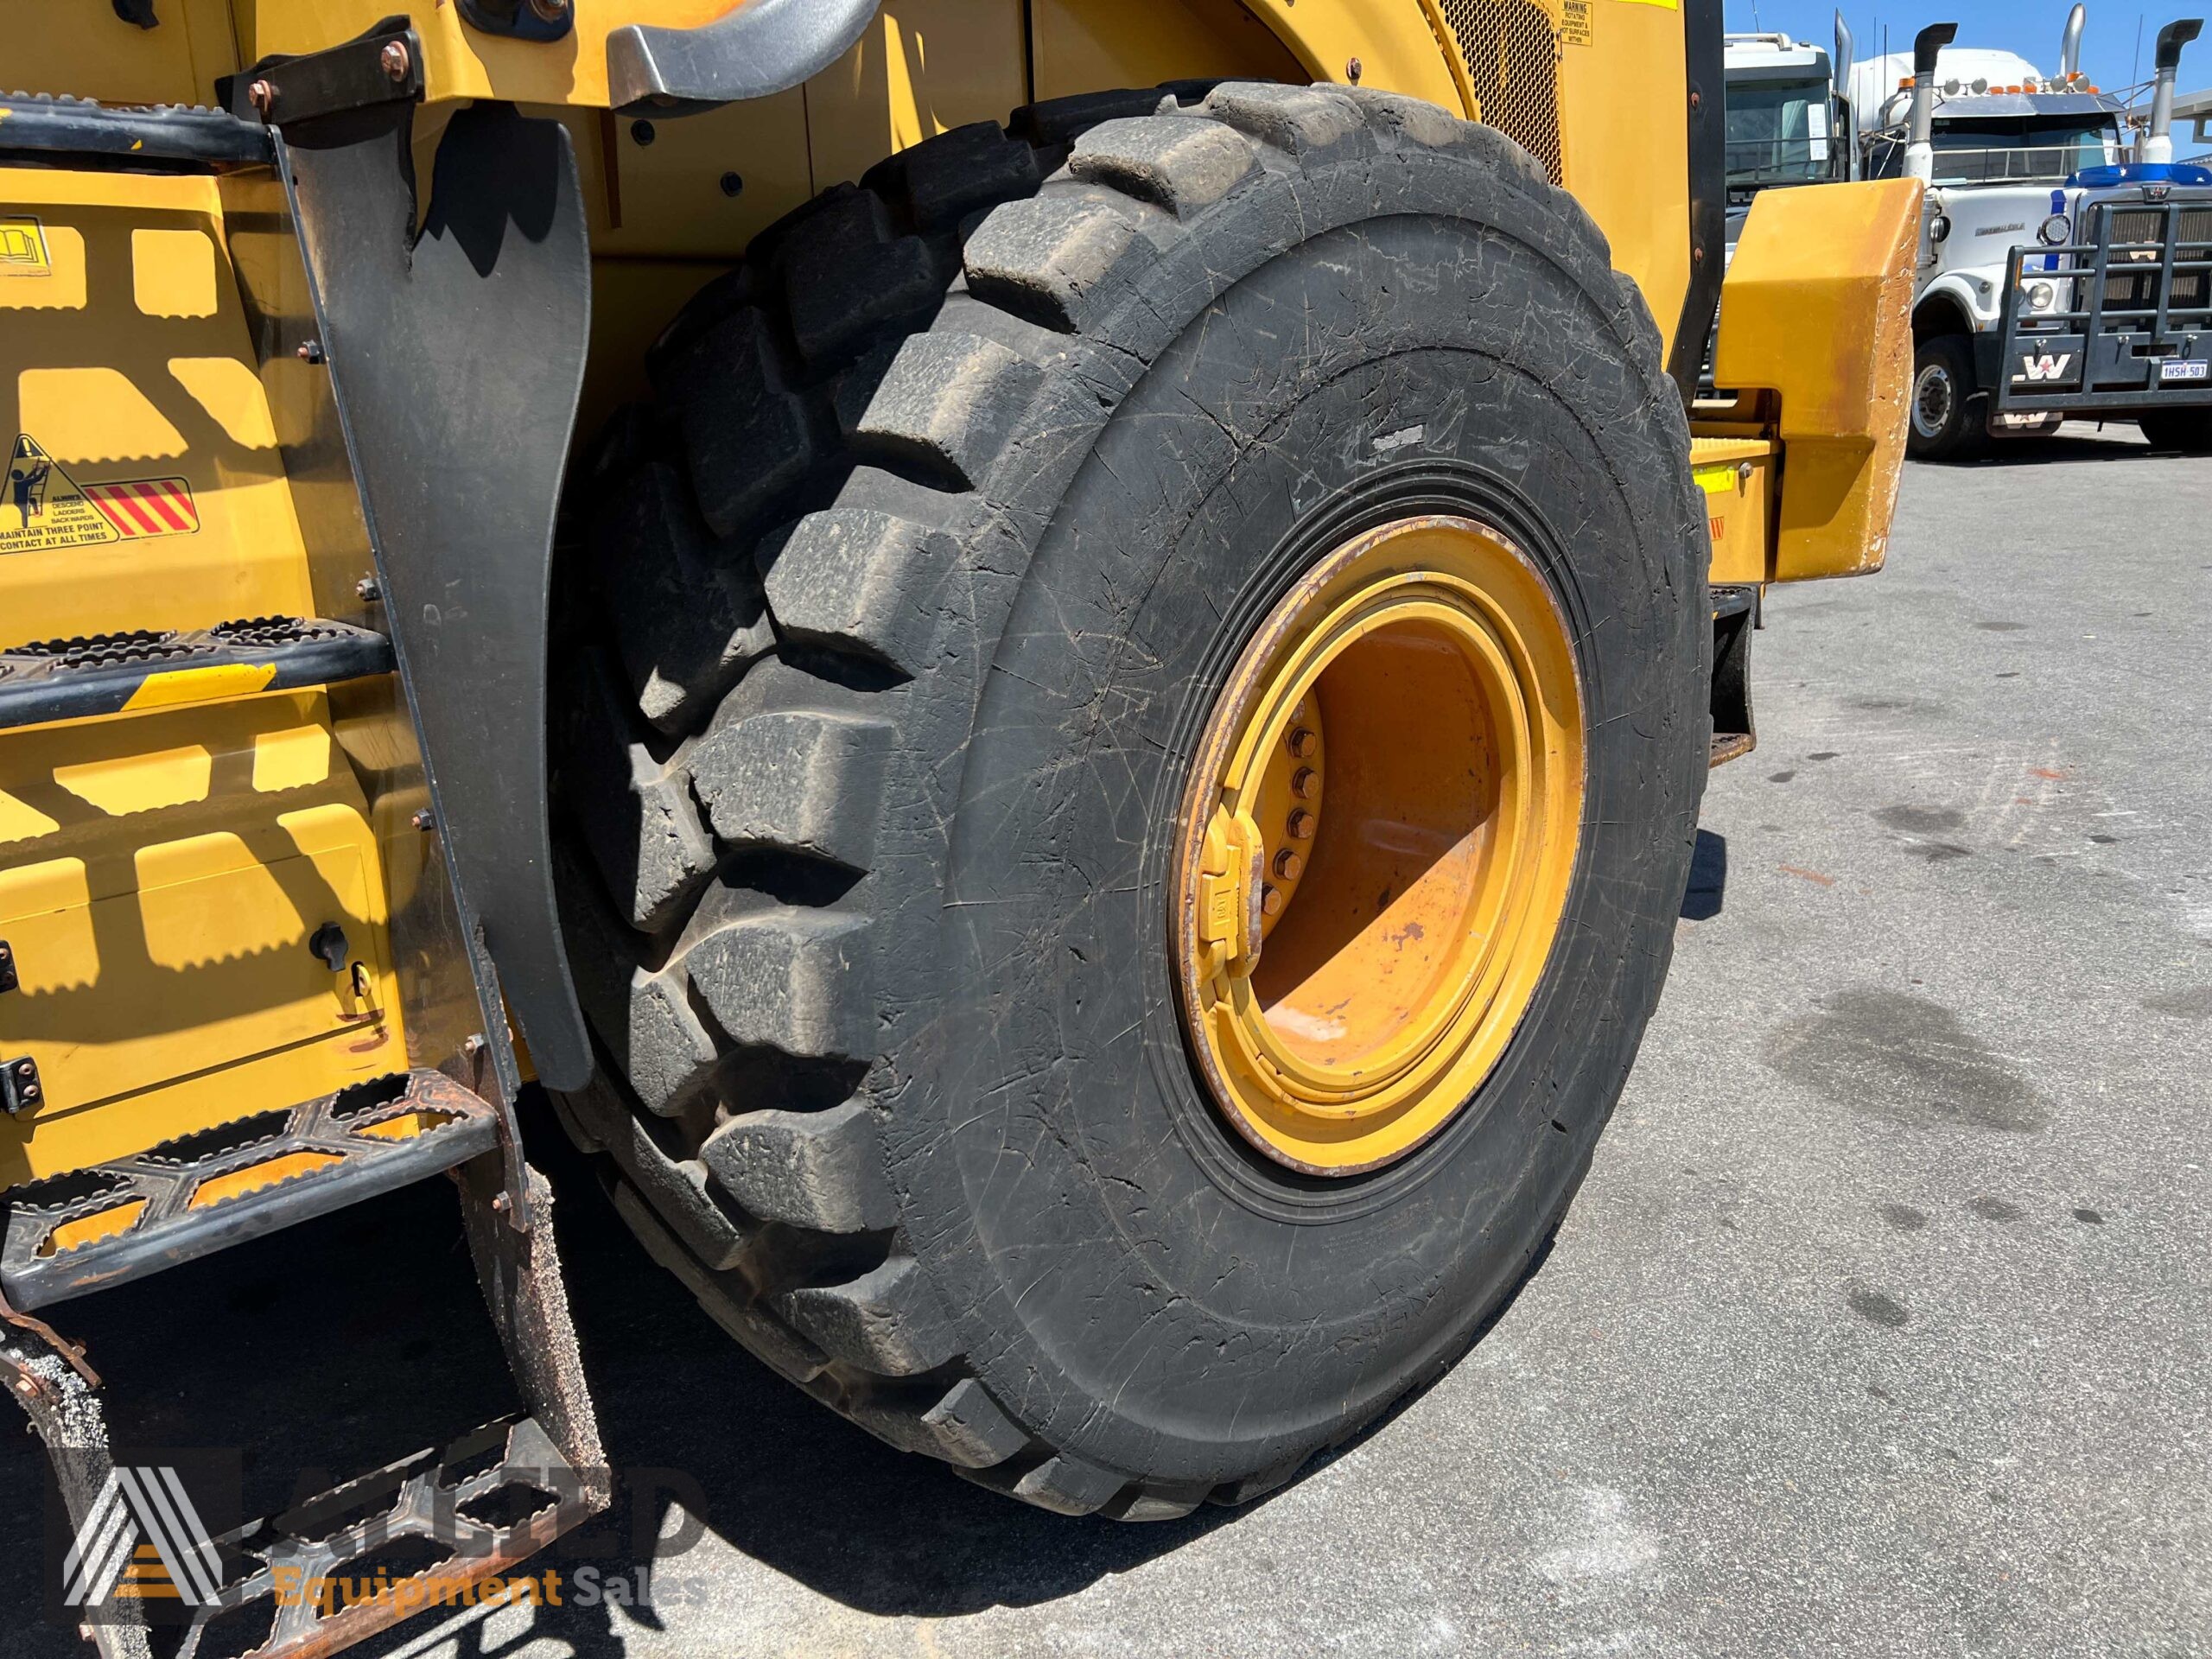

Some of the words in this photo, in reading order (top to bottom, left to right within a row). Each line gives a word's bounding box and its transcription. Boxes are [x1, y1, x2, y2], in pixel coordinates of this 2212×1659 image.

[1564, 1, 1586, 14] WARNING
[44, 525, 74, 535] THREE
[78, 522, 104, 532] POINT
[0, 539, 42, 550] CONTACT
[60, 536, 76, 544] ALL
[78, 532, 107, 542] TIMES
